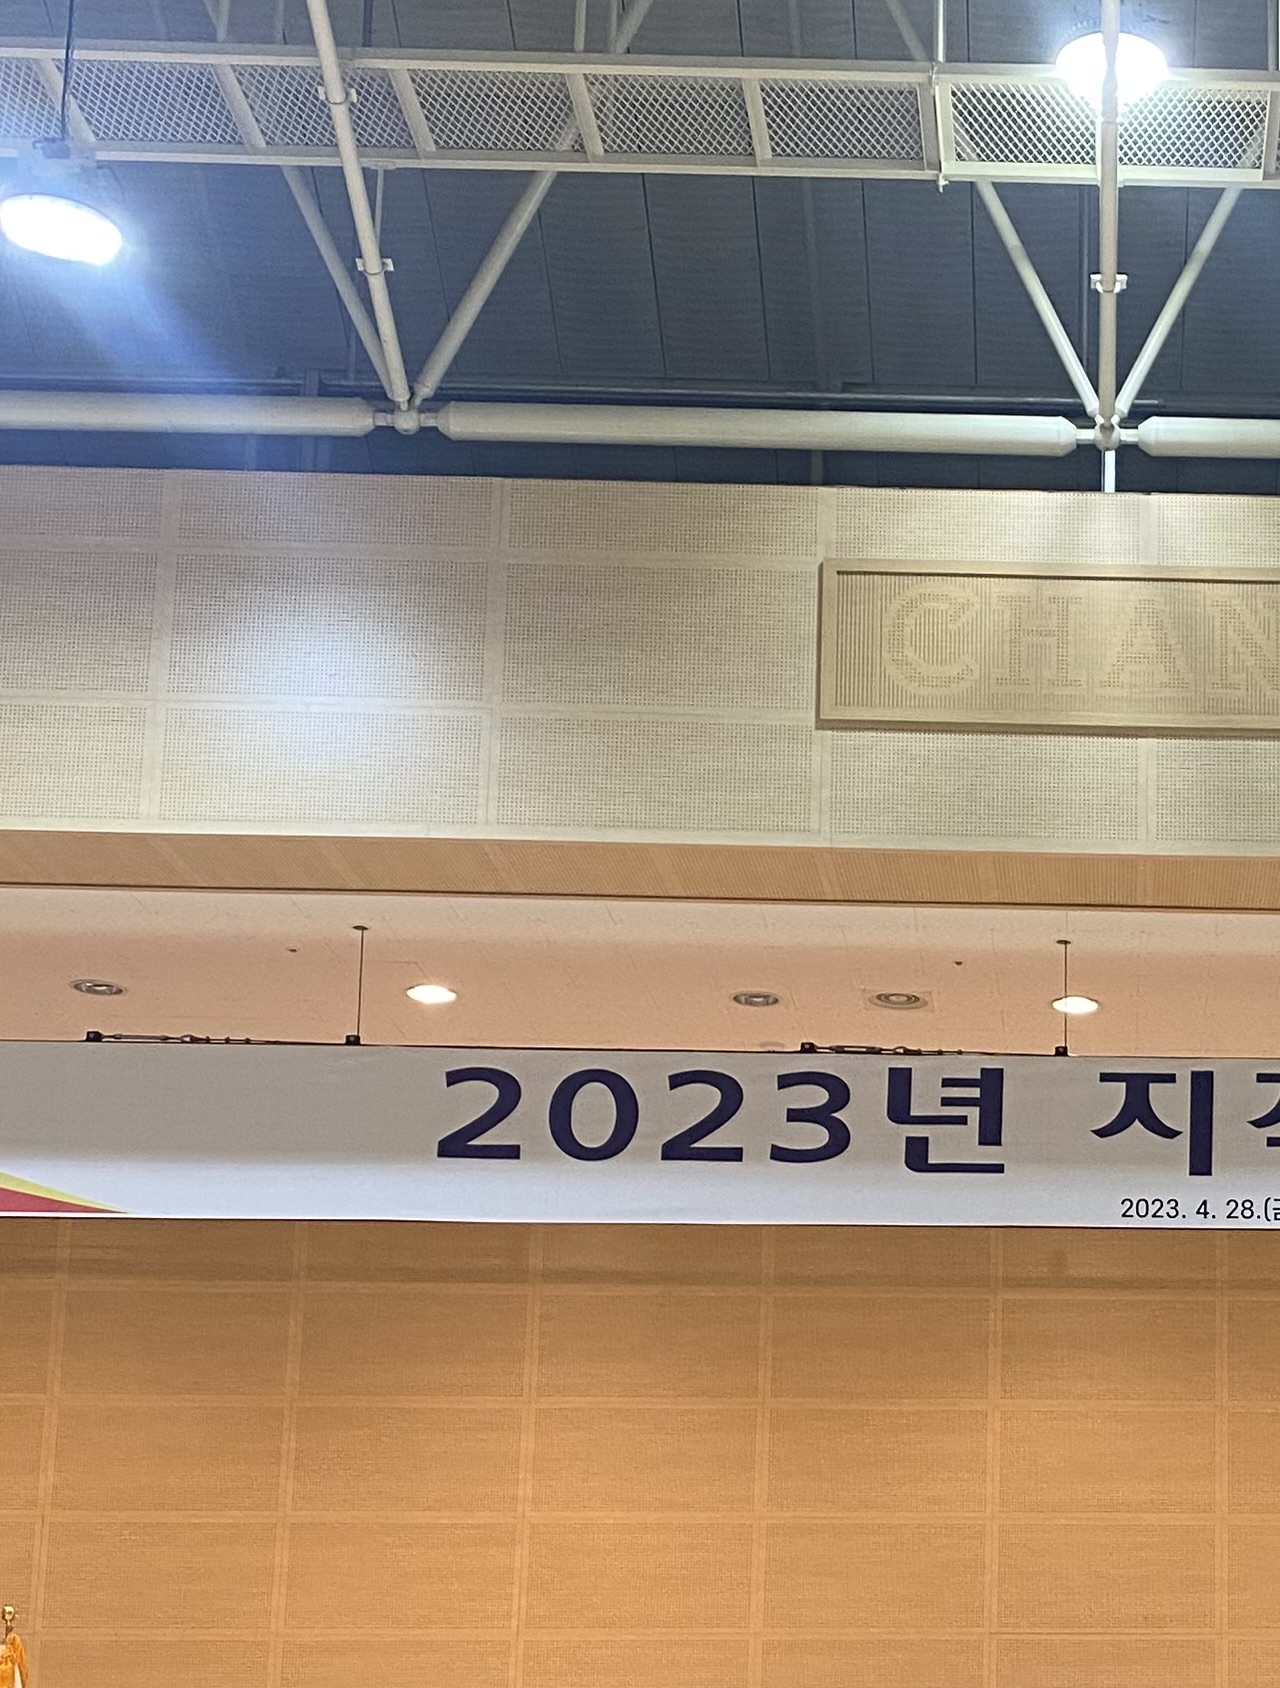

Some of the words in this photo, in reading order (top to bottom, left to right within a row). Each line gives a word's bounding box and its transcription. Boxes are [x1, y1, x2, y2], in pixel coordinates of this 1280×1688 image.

[436, 1066, 1006, 1174] 2023년
[1120, 1198, 1187, 1219] 2023.
[1196, 1199, 1217, 1219] 4.
